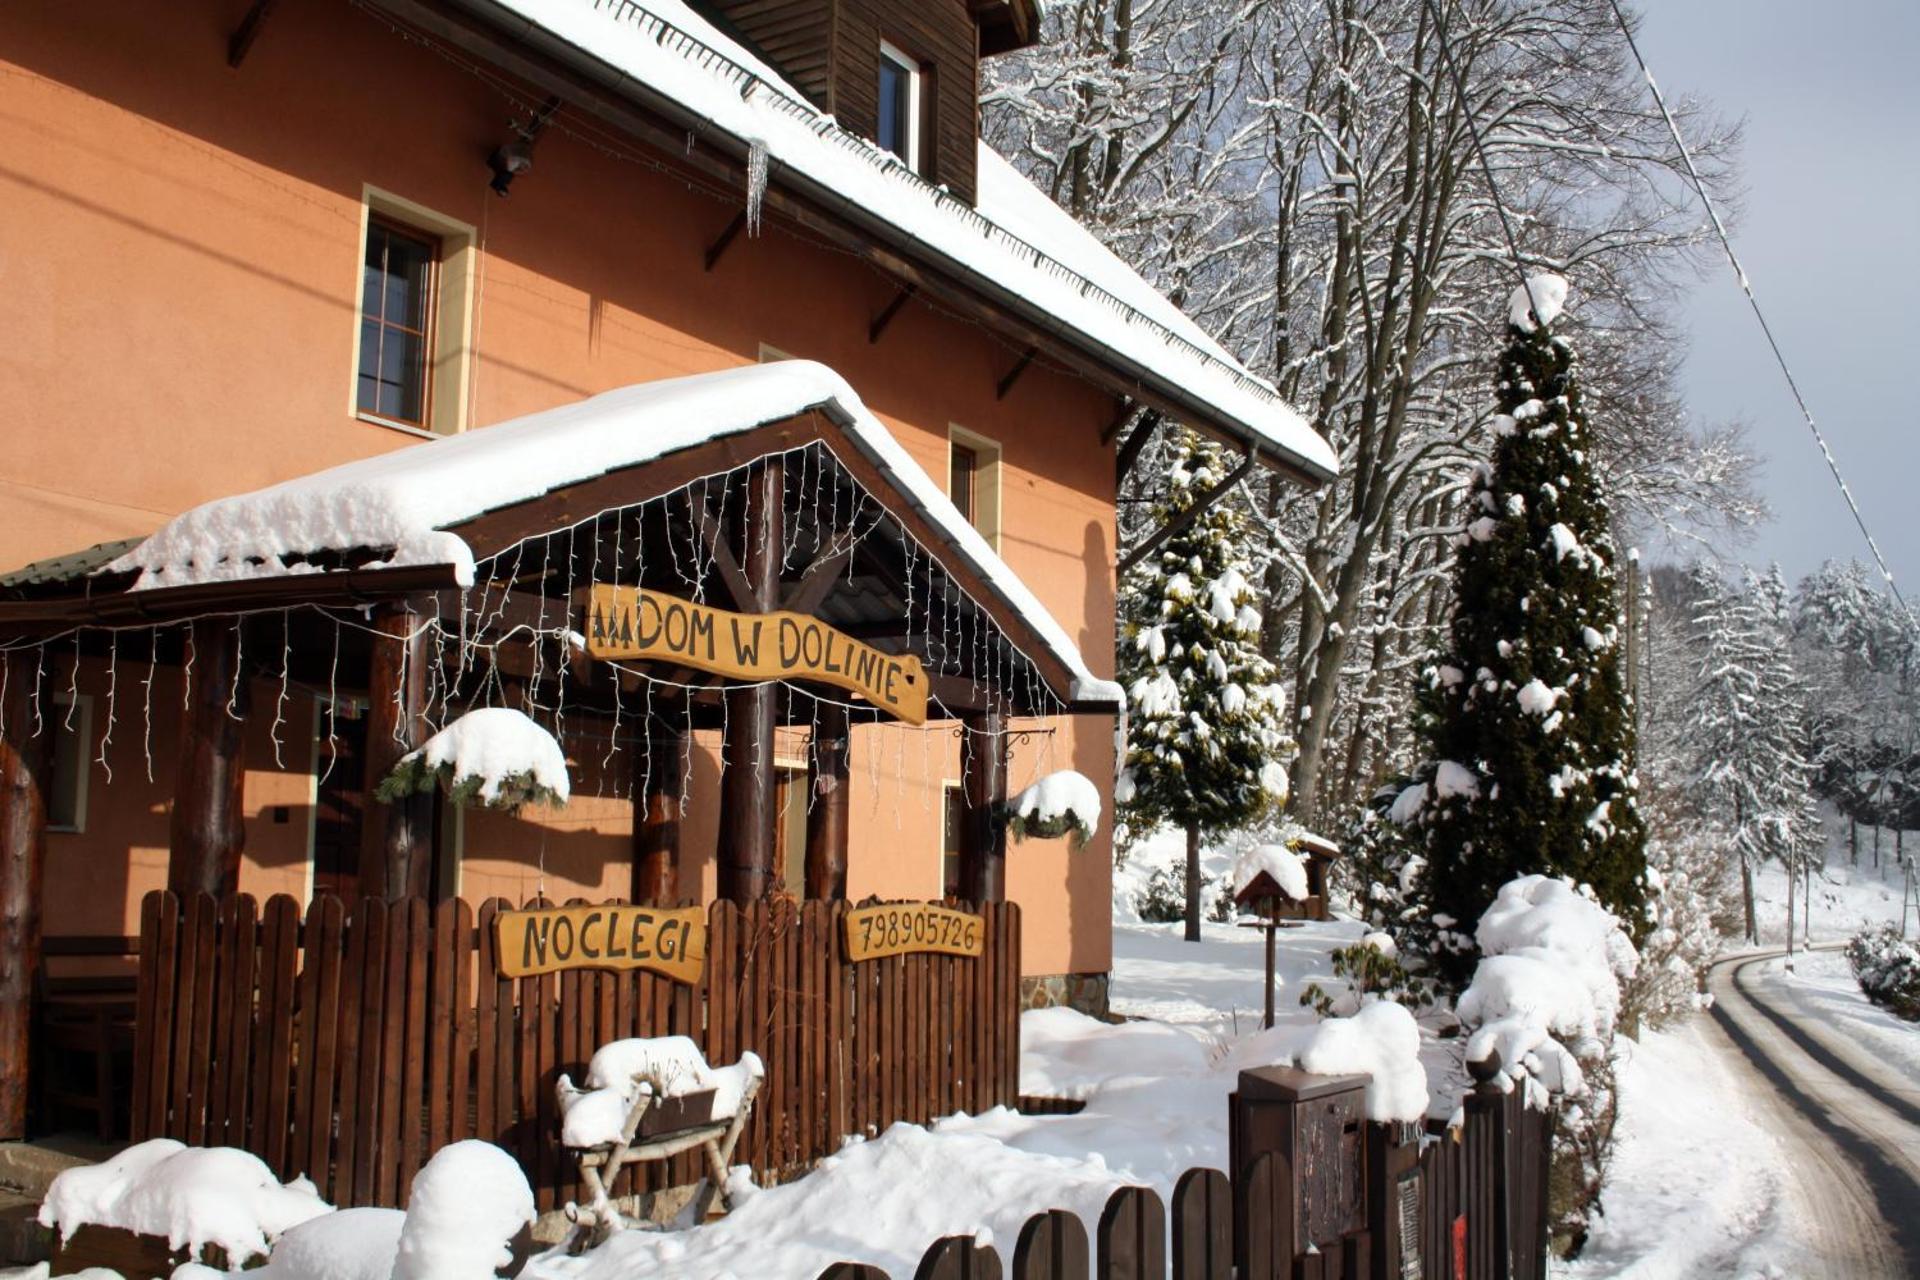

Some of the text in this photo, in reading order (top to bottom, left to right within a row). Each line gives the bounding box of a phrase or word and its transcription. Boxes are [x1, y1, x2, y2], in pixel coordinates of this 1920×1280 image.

[636, 595, 903, 704] DOM W DOLINIE
[522, 912, 691, 968] NOCLEGI
[859, 911, 975, 952] 798905726
